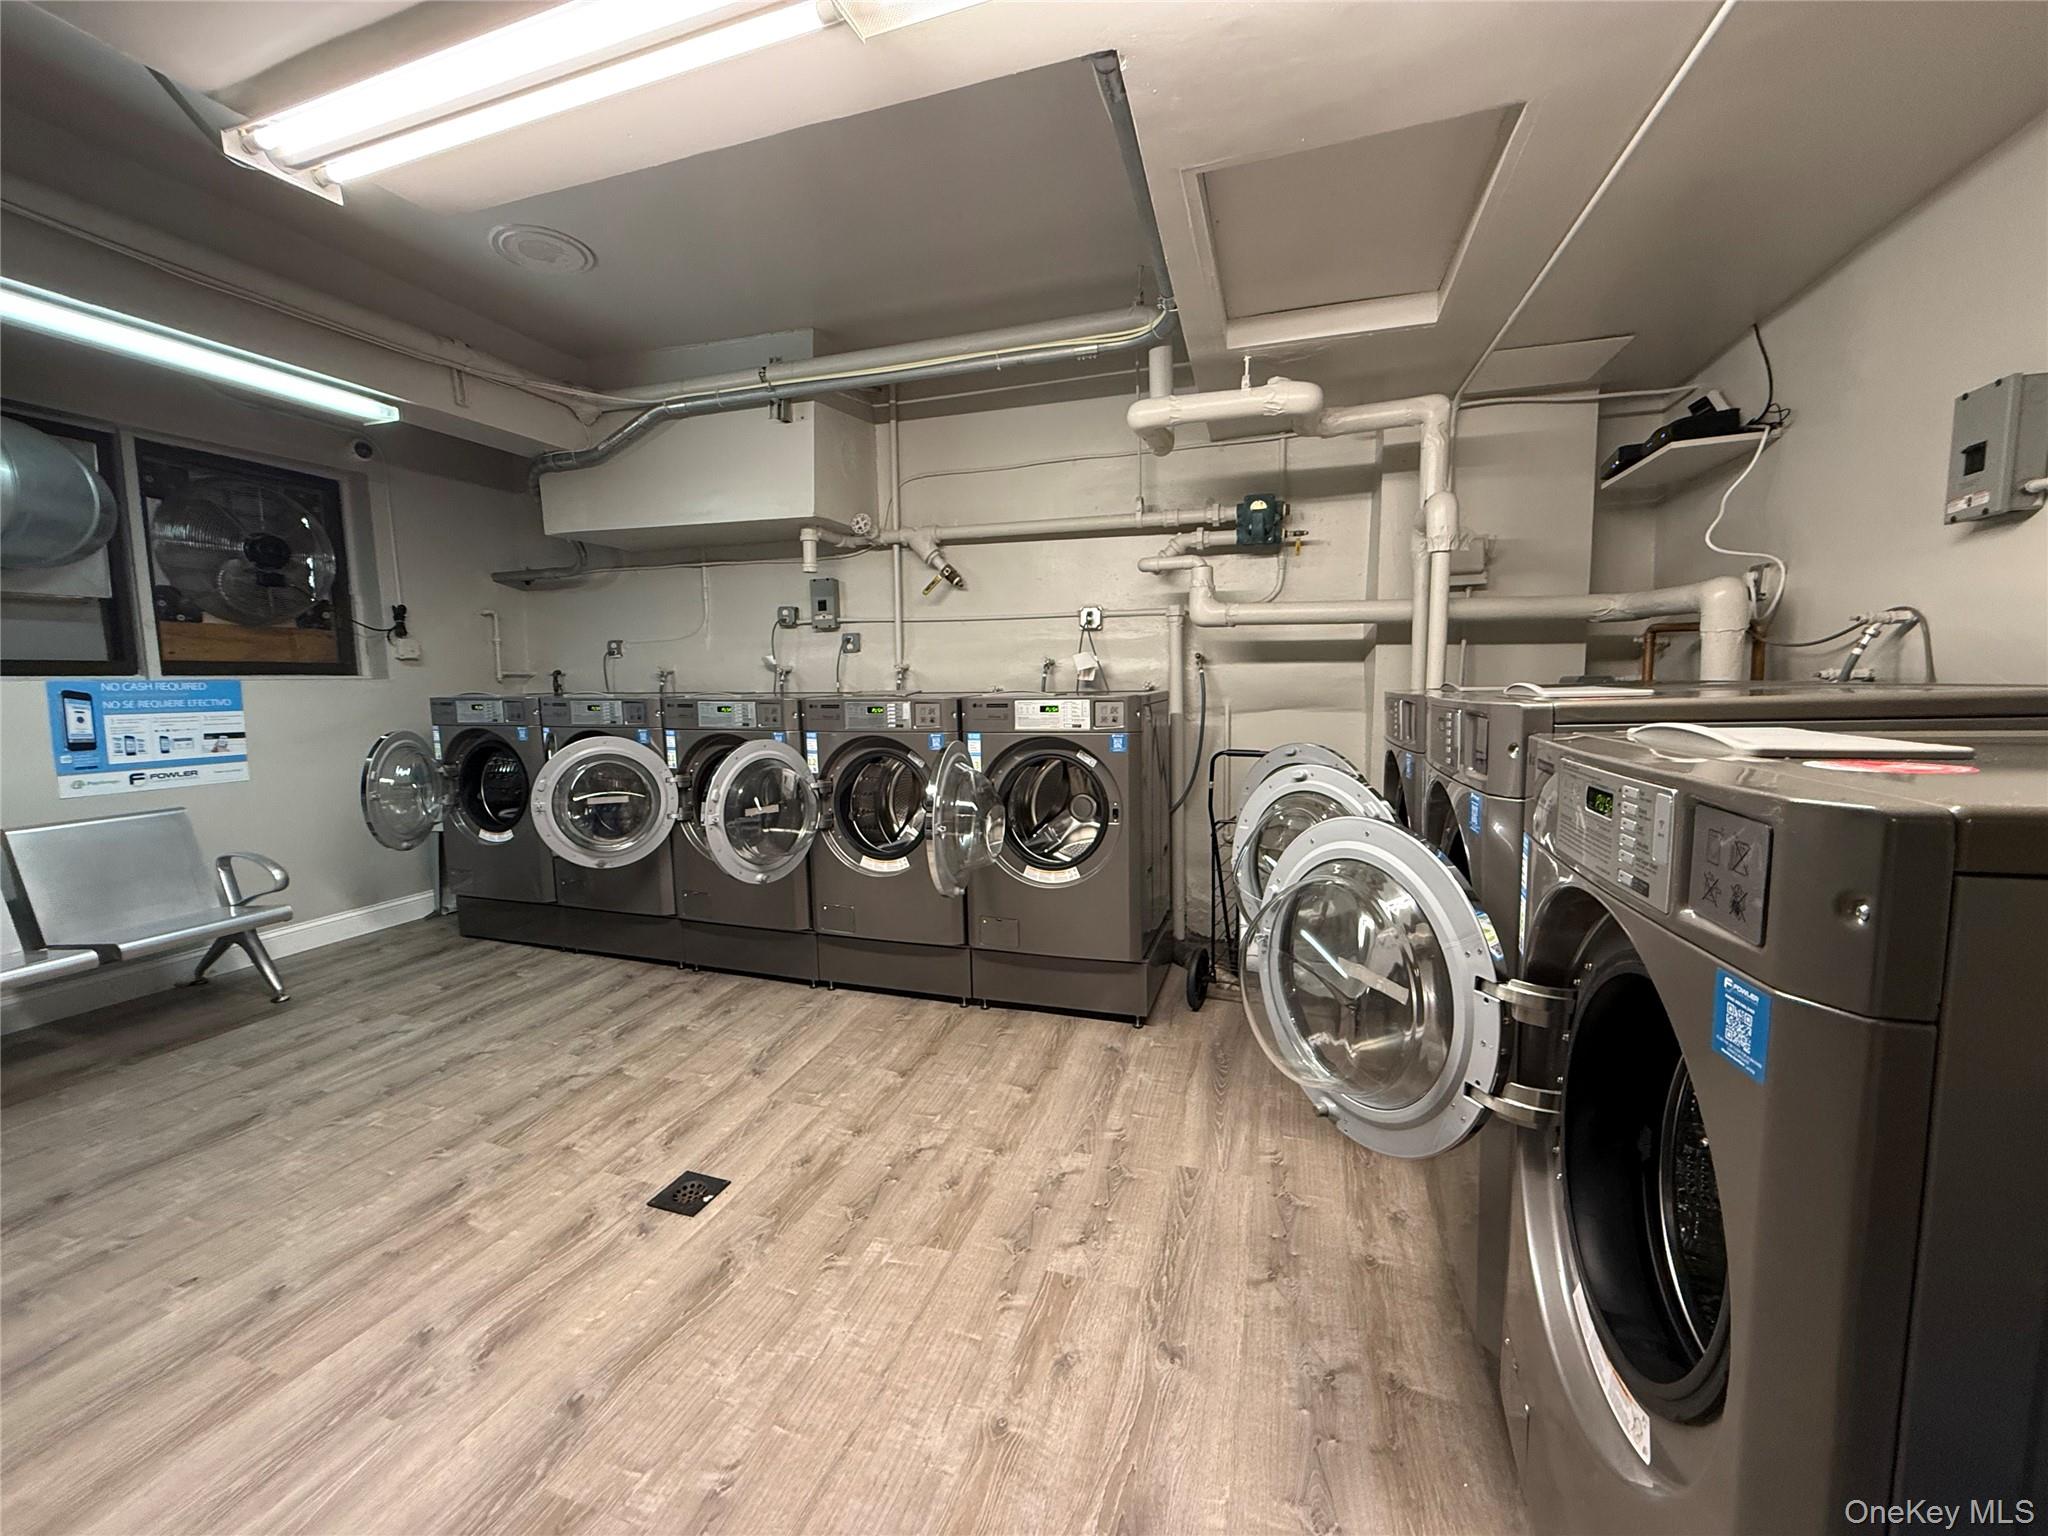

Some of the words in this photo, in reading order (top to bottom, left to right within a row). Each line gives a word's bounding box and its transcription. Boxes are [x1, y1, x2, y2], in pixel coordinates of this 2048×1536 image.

[100, 682, 120, 692] NO
[122, 682, 153, 691] CASH
[155, 681, 208, 691] REQUIRED
[102, 700, 120, 709] NO
[121, 700, 134, 709] SE
[138, 699, 184, 708] REQUIERE
[187, 698, 232, 707] EFECTIVO
[150, 769, 199, 780] FOWLER
[1733, 983, 1759, 1004] FOWLER
